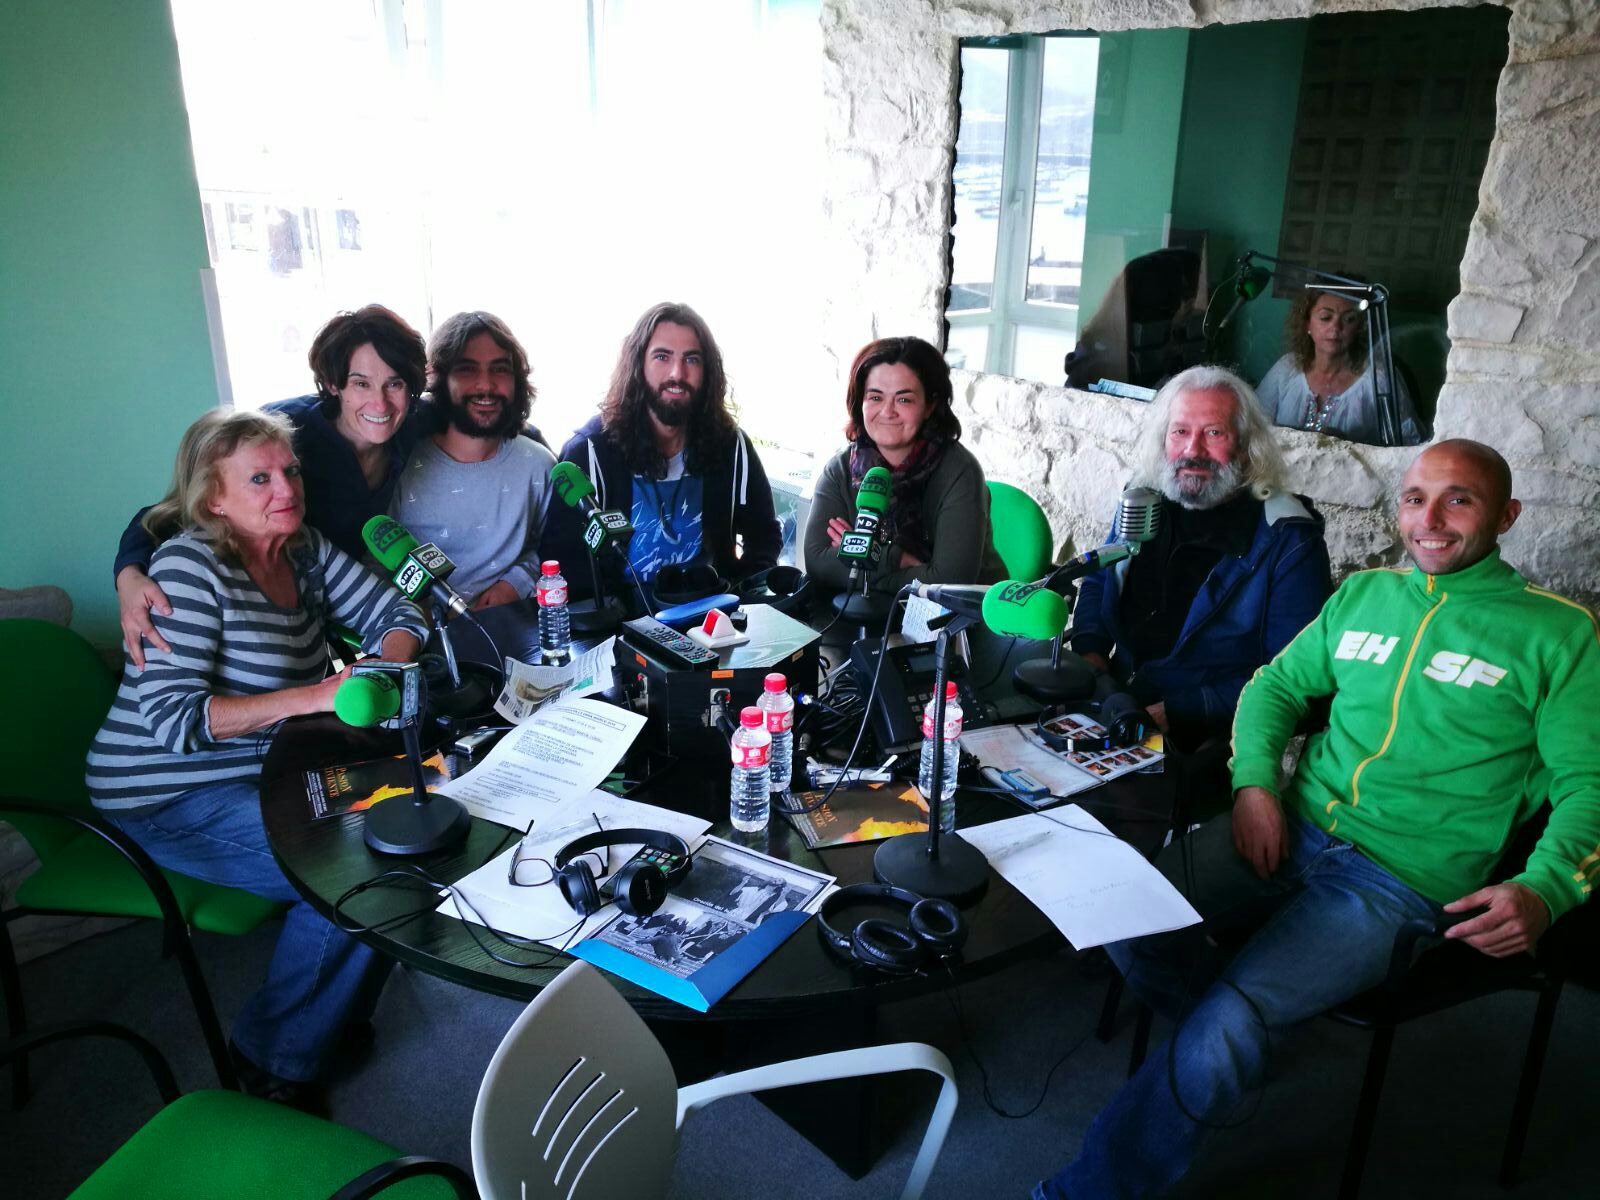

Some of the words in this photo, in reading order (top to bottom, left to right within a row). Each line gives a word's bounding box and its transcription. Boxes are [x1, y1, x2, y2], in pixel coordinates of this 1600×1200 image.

[400, 566, 416, 586] ONDA
[408, 572, 423, 591] CERO
[1334, 630, 1400, 665] EH
[1422, 650, 1509, 689] SF
